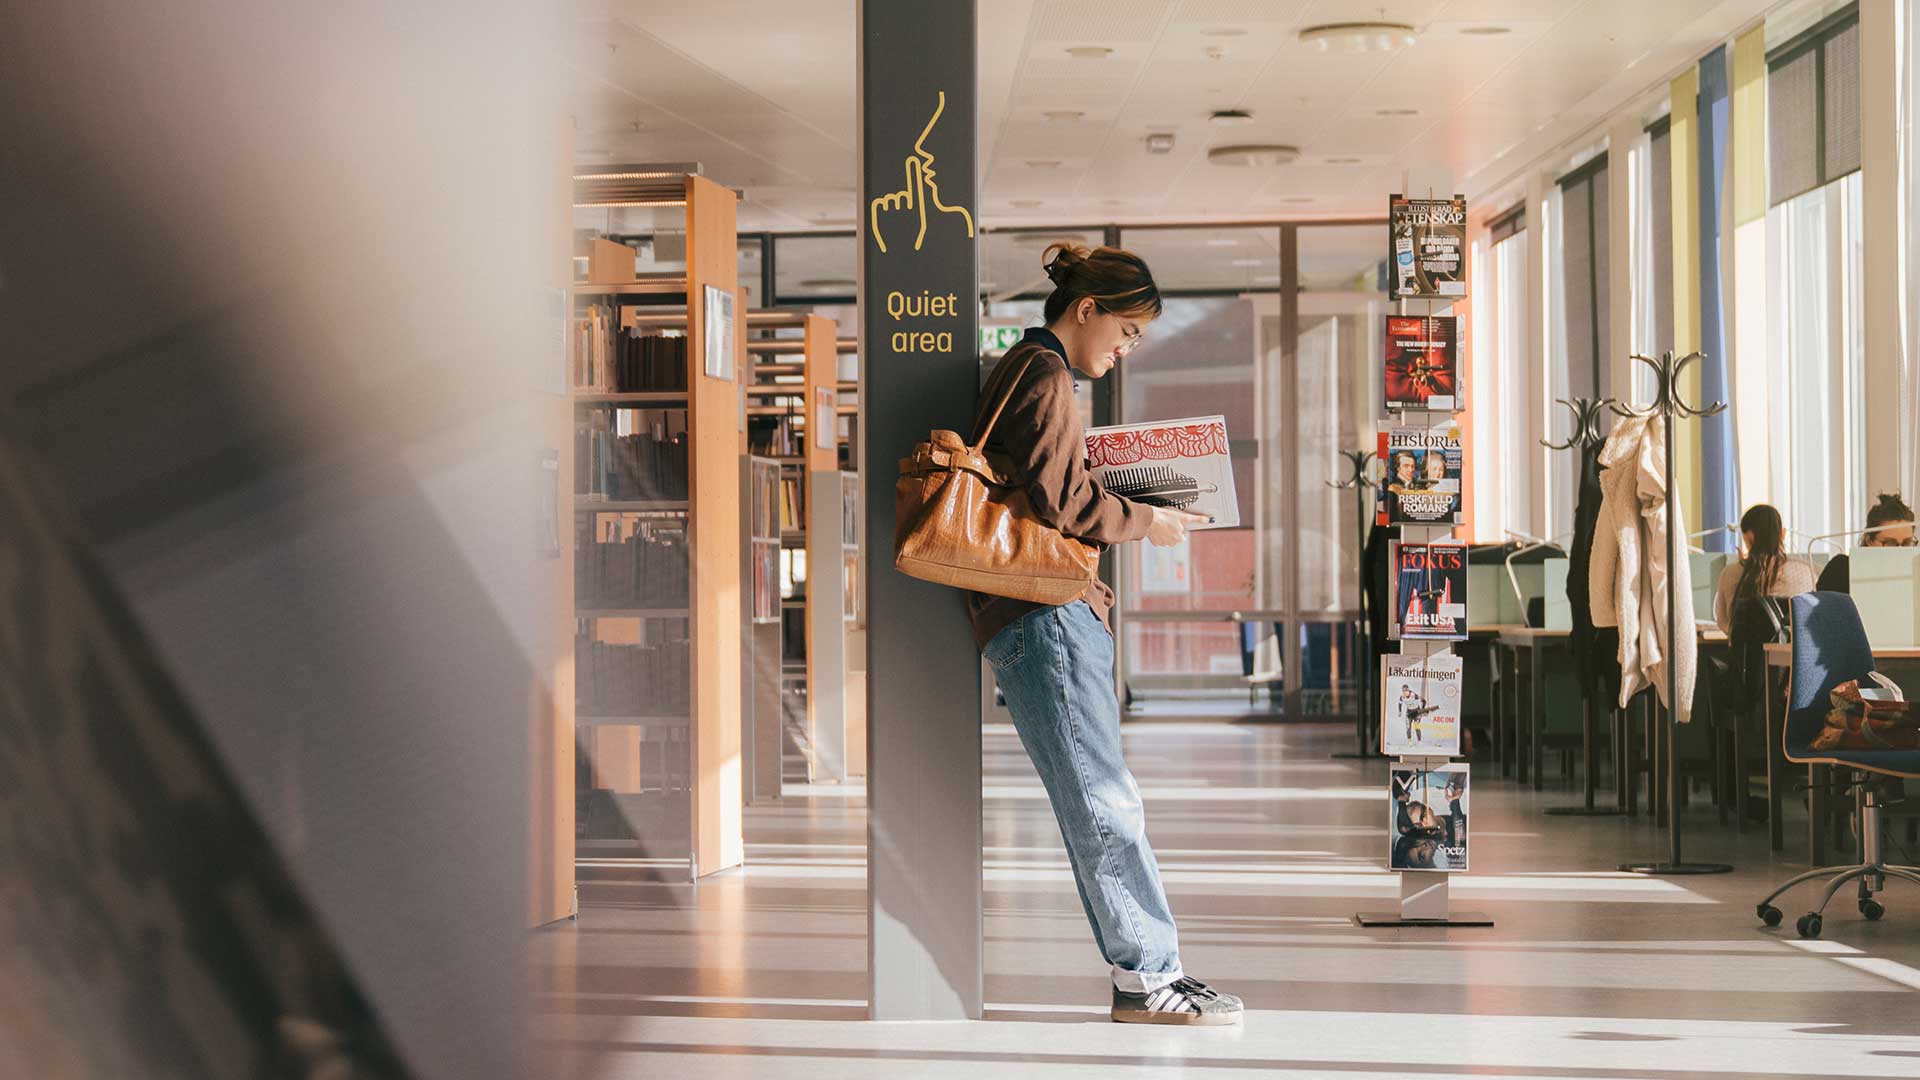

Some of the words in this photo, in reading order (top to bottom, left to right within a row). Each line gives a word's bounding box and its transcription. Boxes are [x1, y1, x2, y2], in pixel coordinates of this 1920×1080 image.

[1403, 212, 1463, 225] ETENSKAP
[887, 290, 958, 320] Quiet
[891, 332, 952, 353] area
[1398, 494, 1453, 504] RISKFYLLD
[1403, 503, 1449, 513] ROMANS
[1402, 553, 1462, 569] FOKUS
[1407, 613, 1430, 626] Exit
[1431, 613, 1456, 626] USA
[1388, 666, 1456, 681] Läkartidningen
[1437, 843, 1465, 857] Spetz
